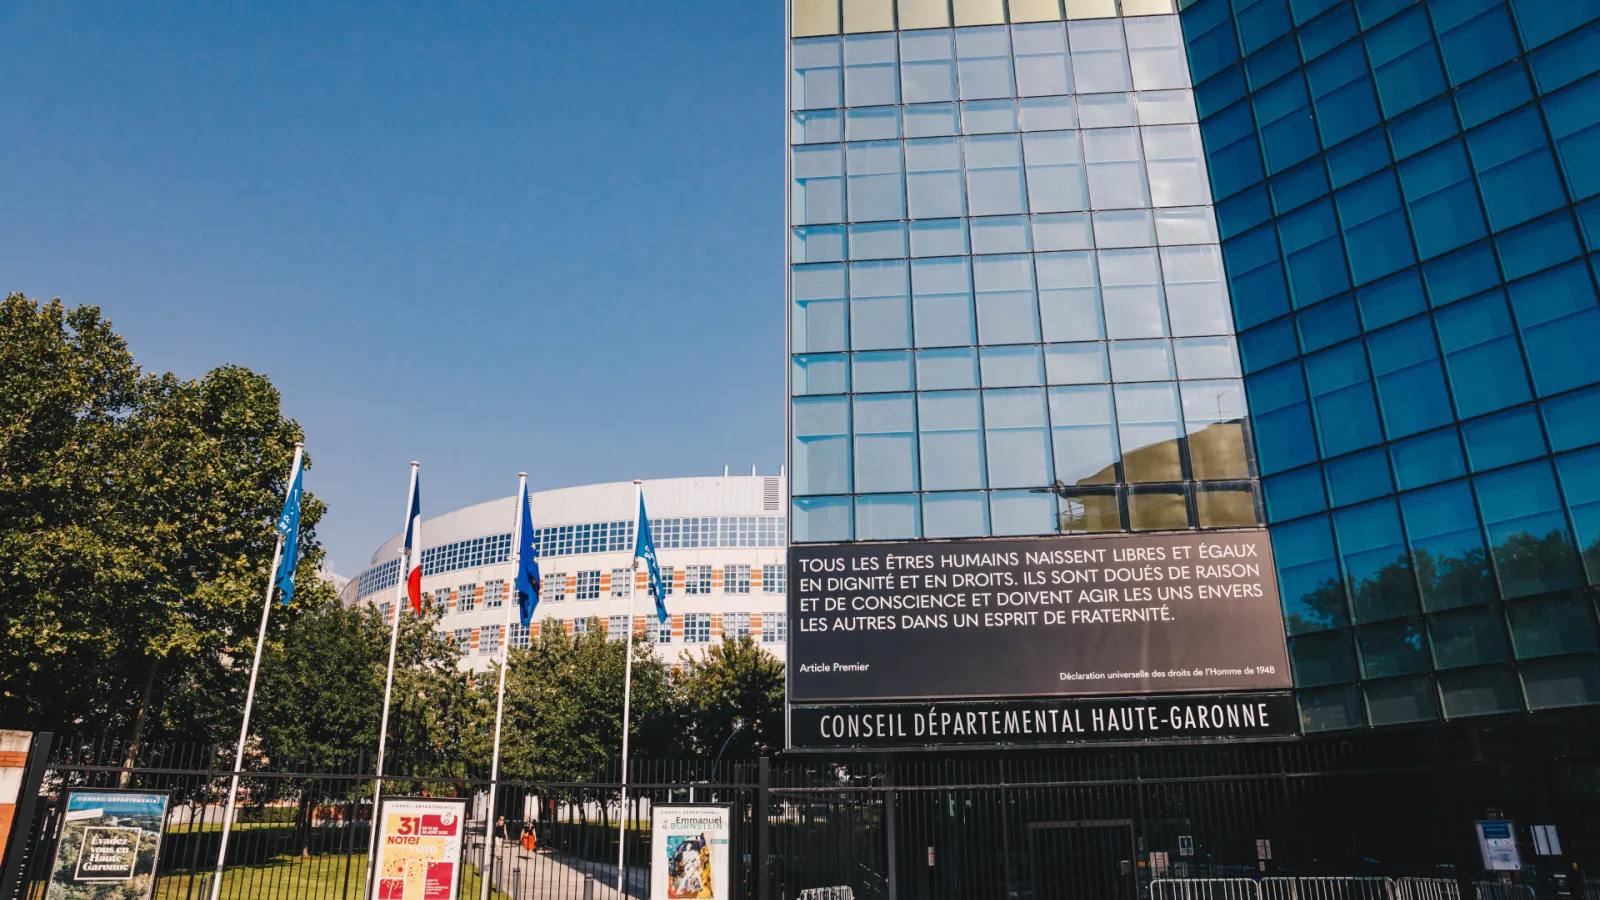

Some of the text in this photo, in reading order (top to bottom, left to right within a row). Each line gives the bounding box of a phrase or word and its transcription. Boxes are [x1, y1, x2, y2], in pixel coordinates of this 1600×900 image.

[799, 543, 1257, 572] TOUS LES ÊTRES HUMAINS NAISSENT LIBRES ET ÉGAUX
[800, 564, 1259, 592] EN DIGNITÉ ET EN DROITS. ILS SONT DOUÉS DE RAISON
[800, 584, 1263, 612] ET DE CONSCIENCE ET DOIVENT AGIR LES UNS ENVERS
[801, 604, 1174, 632] LES AUTRES DANS UN ESPRIT DE FRATERNITÉ.
[800, 662, 869, 672] Article Premier
[1060, 672, 1105, 680] Déclaration
[1108, 670, 1149, 679] universelle
[1168, 669, 1191, 677] droits
[1193, 668, 1203, 676] de
[1256, 666, 1275, 674] 1948
[821, 703, 1269, 738] CONSEIL DÉPARTEMENTAL HAUTE-GARONNE
[397, 817, 420, 835] 31
[676, 816, 722, 824] Emmanuel
[89, 853, 126, 862] Haute-
[90, 846, 129, 854] vous en
[82, 862, 129, 871] Garonne
